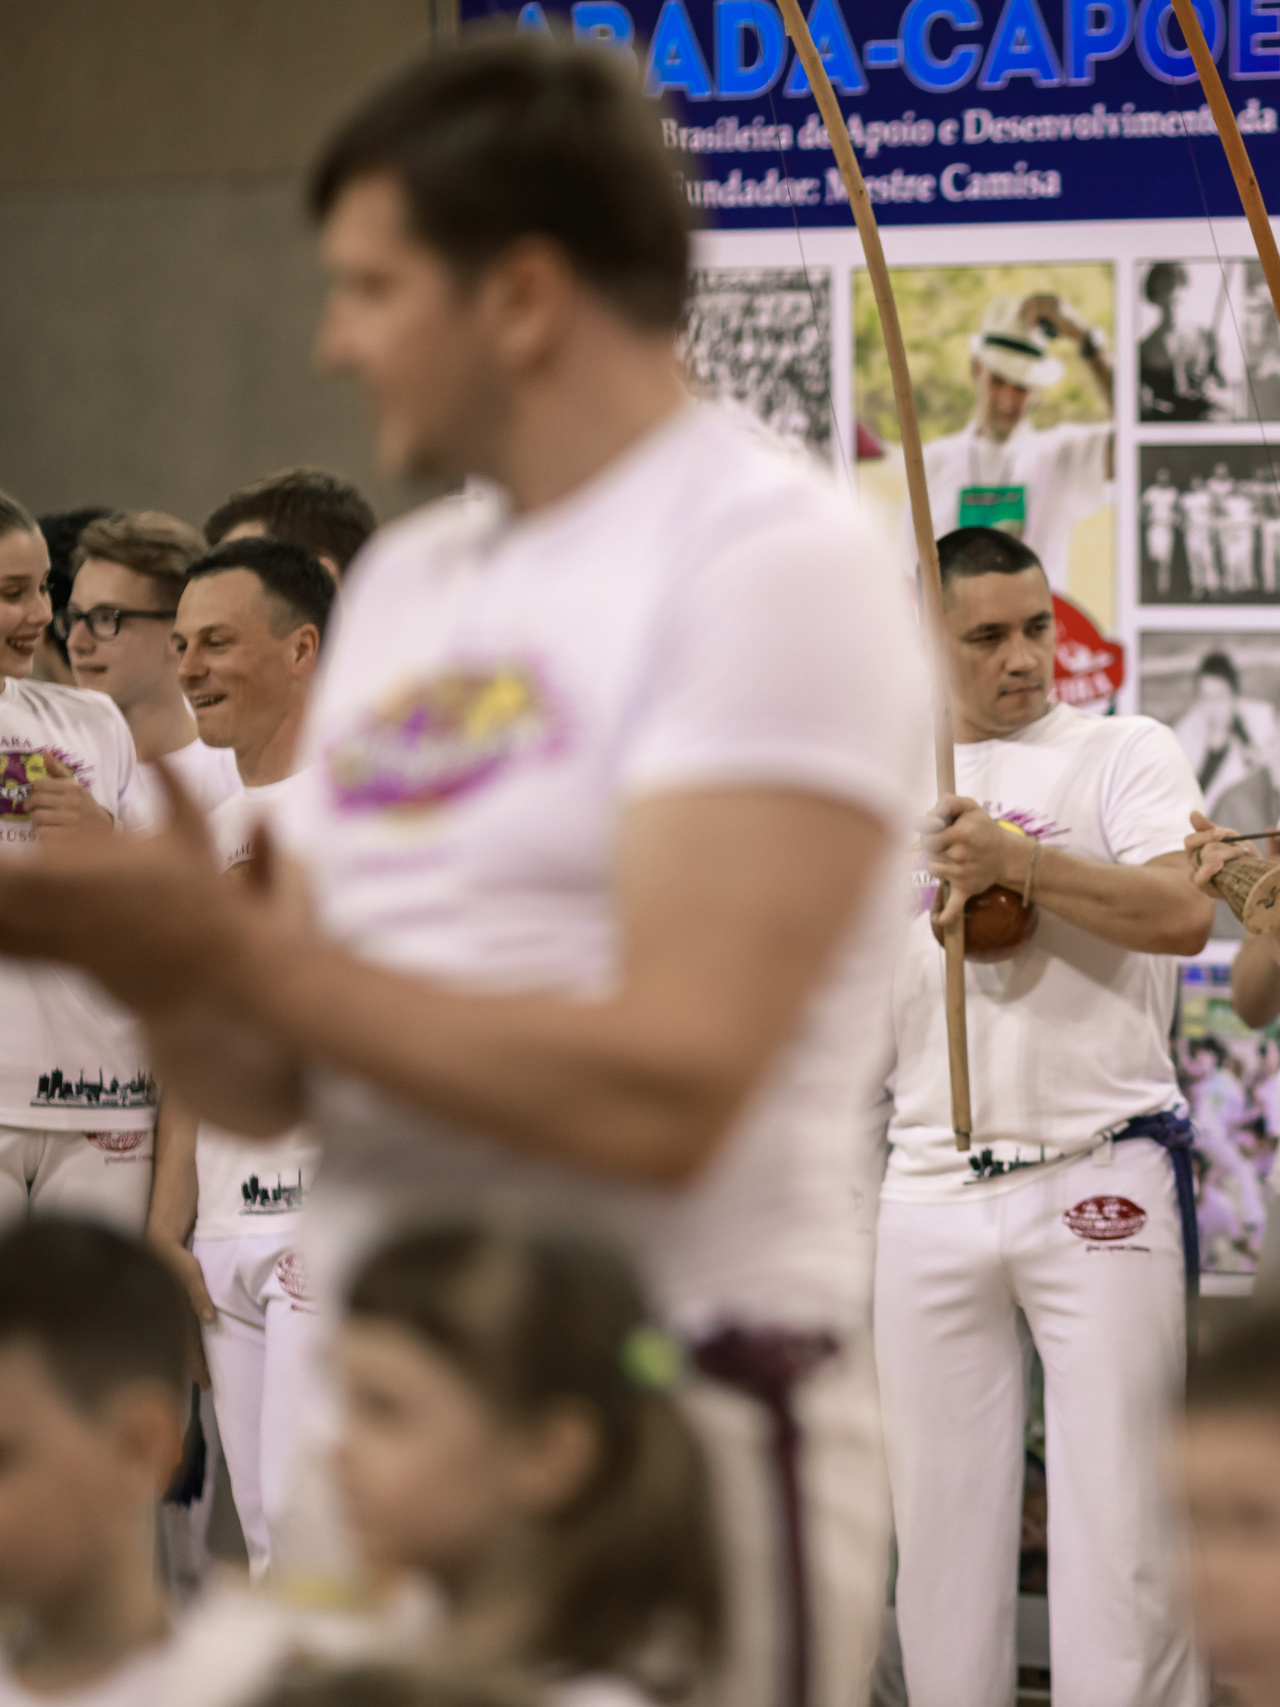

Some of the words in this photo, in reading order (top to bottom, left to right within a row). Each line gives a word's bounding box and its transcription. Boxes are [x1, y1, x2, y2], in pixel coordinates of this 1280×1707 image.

[661, 115, 793, 153] Brasileira
[846, 103, 935, 158] Apoio
[938, 118, 960, 146] e
[962, 102, 1219, 145] Desenvolviment
[1236, 98, 1278, 134] da
[940, 160, 1062, 202] Camisa
